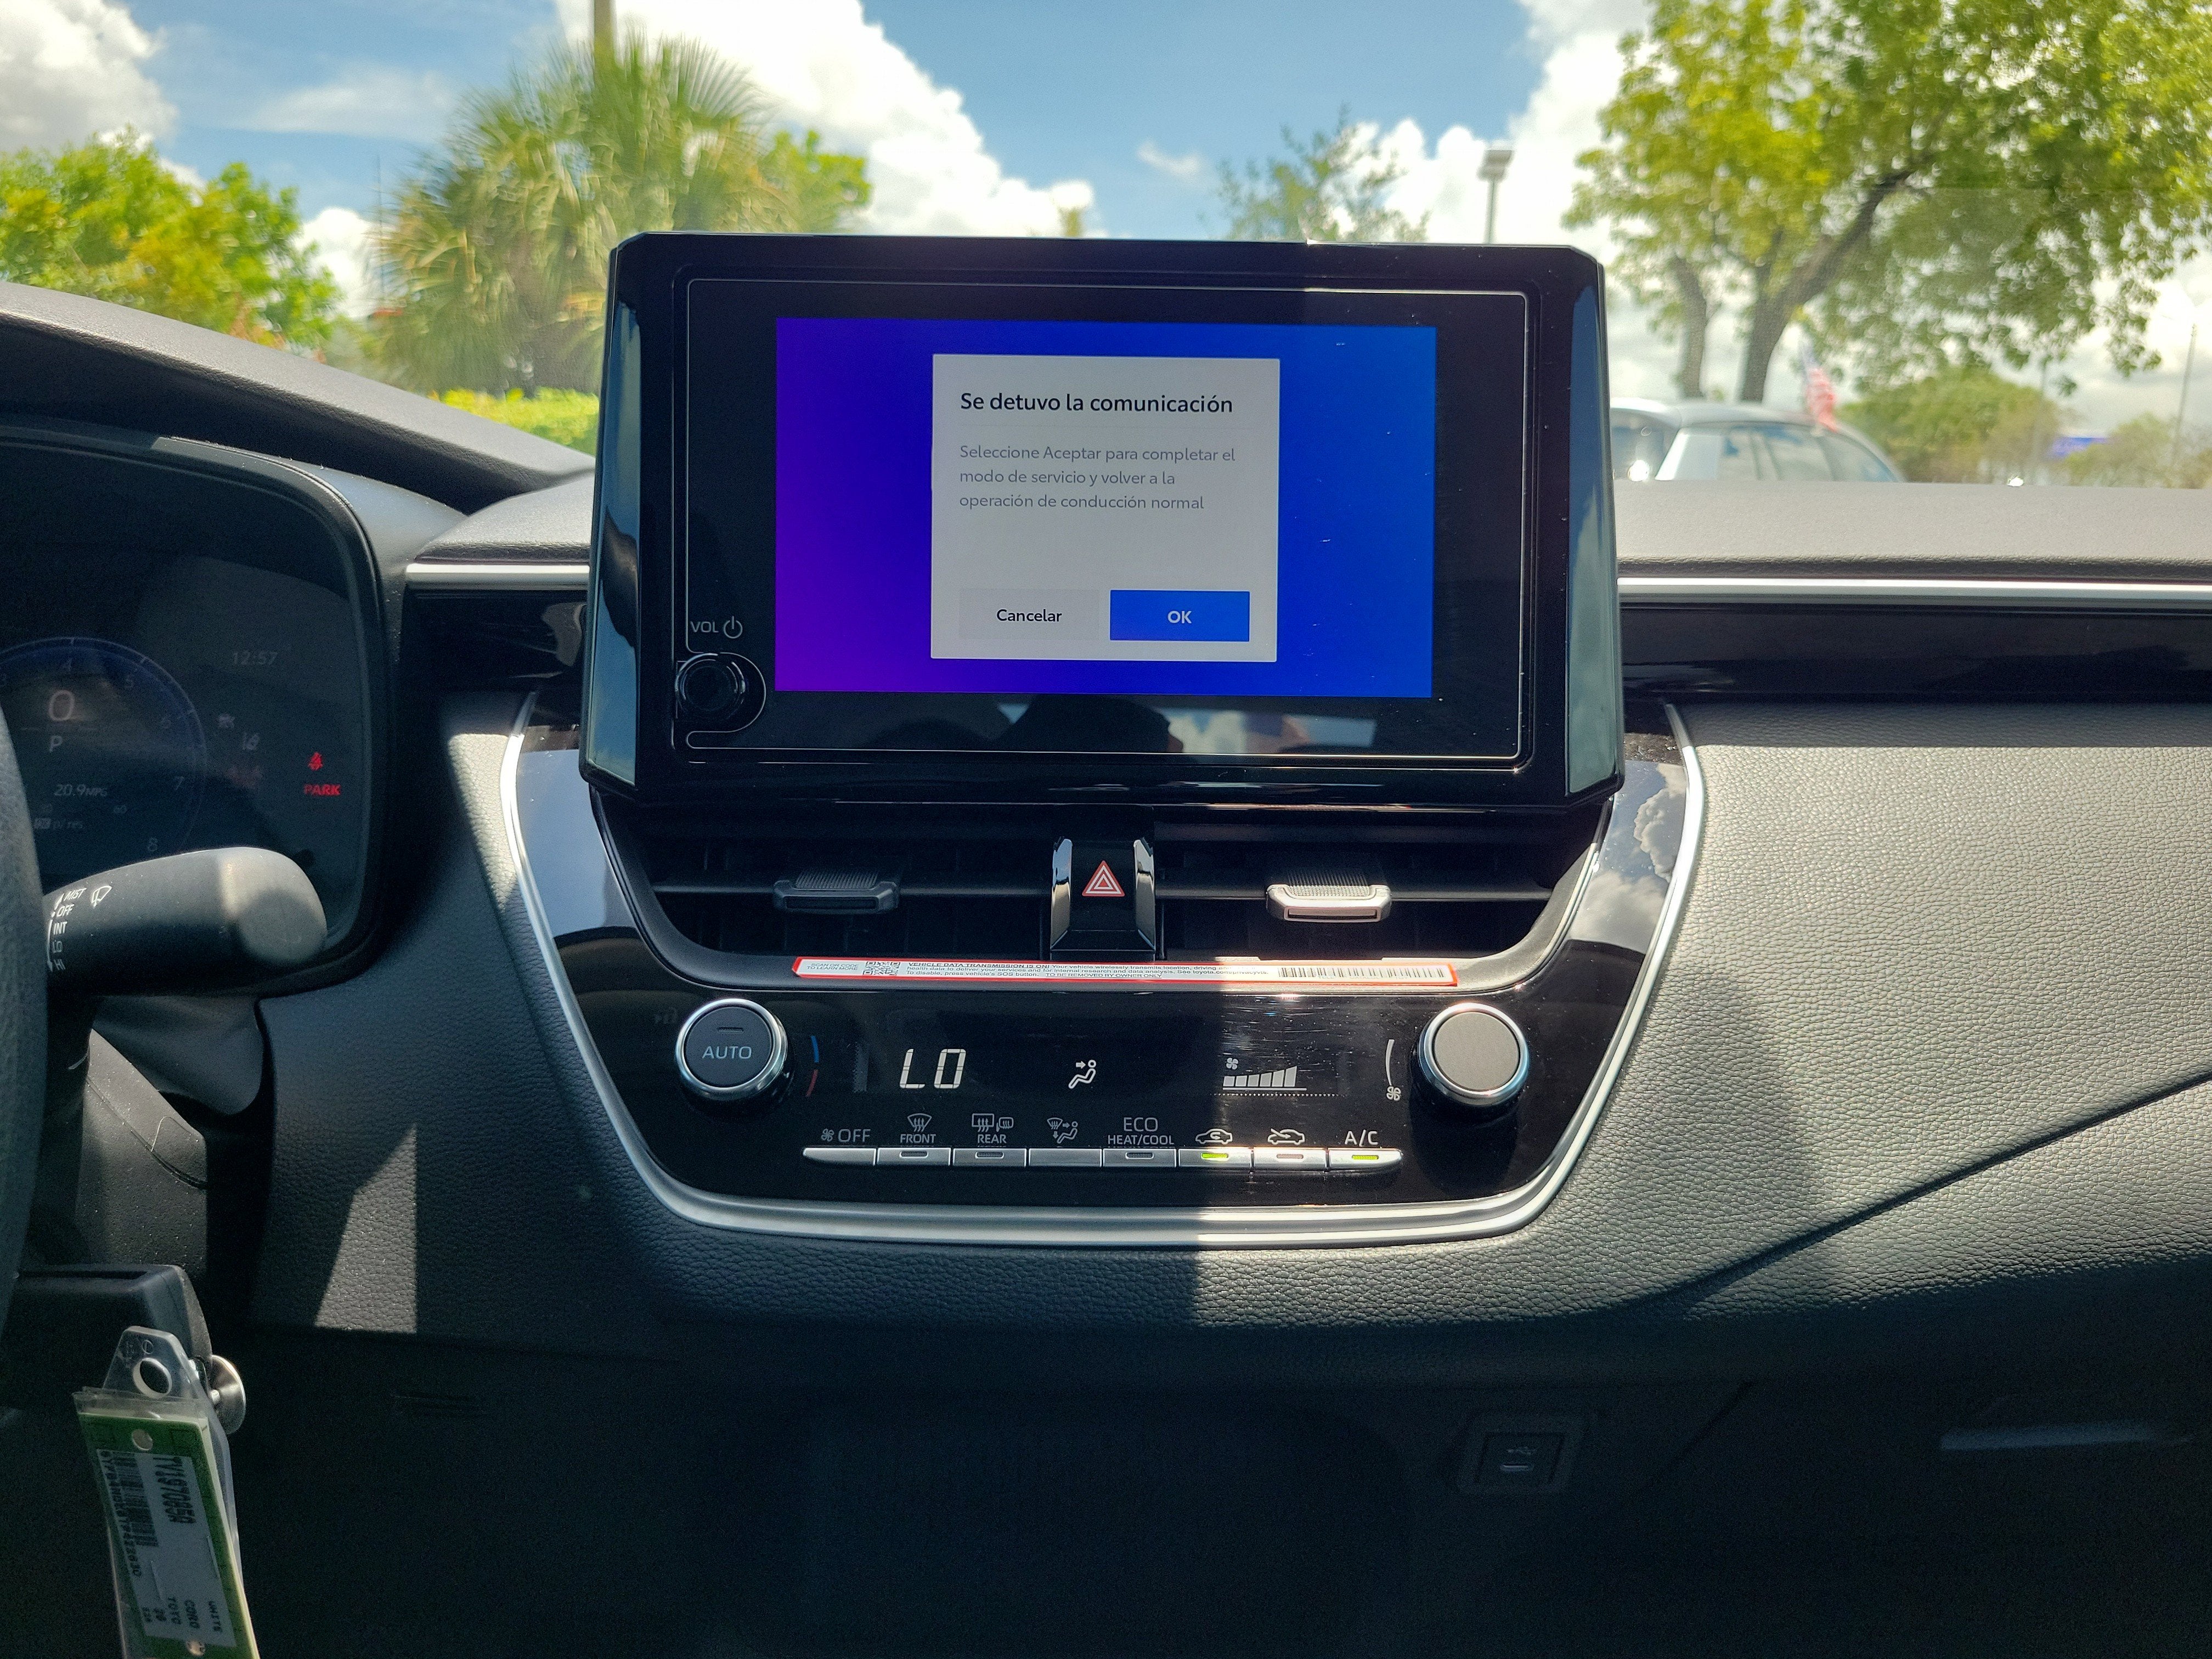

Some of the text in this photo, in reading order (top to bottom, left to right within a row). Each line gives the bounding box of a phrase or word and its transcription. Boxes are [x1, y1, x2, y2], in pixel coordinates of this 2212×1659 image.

[961, 393, 1232, 413] Se detuvo la comunicación
[961, 445, 1235, 464] Seleccione Aceptar para completar el
[961, 470, 1175, 487] modo de servicio y volver a la
[960, 494, 1204, 510] operación de conducción normal
[996, 608, 1062, 622] Cancelar
[1167, 610, 1192, 624] OK
[690, 621, 719, 633] VOL
[48, 690, 75, 721] 0
[50, 734, 64, 753] P
[303, 783, 342, 797] PARK
[63, 888, 87, 901] MIST
[56, 904, 75, 917] OFF
[53, 921, 68, 935] INT
[52, 940, 63, 953] LO
[54, 958, 66, 970] HI
[702, 1046, 752, 1060] AUTO
[899, 1048, 967, 1089] LO
[1124, 1117, 1158, 1132] ECO
[838, 1128, 871, 1143] OFF
[900, 1133, 936, 1144] FRONT
[977, 1133, 1007, 1144] REAR
[1108, 1134, 1175, 1146] HEAT/COOL
[1344, 1130, 1379, 1146] A/C
[167, 1595, 182, 1625] TOYO
[208, 1600, 223, 1632] WHITE
